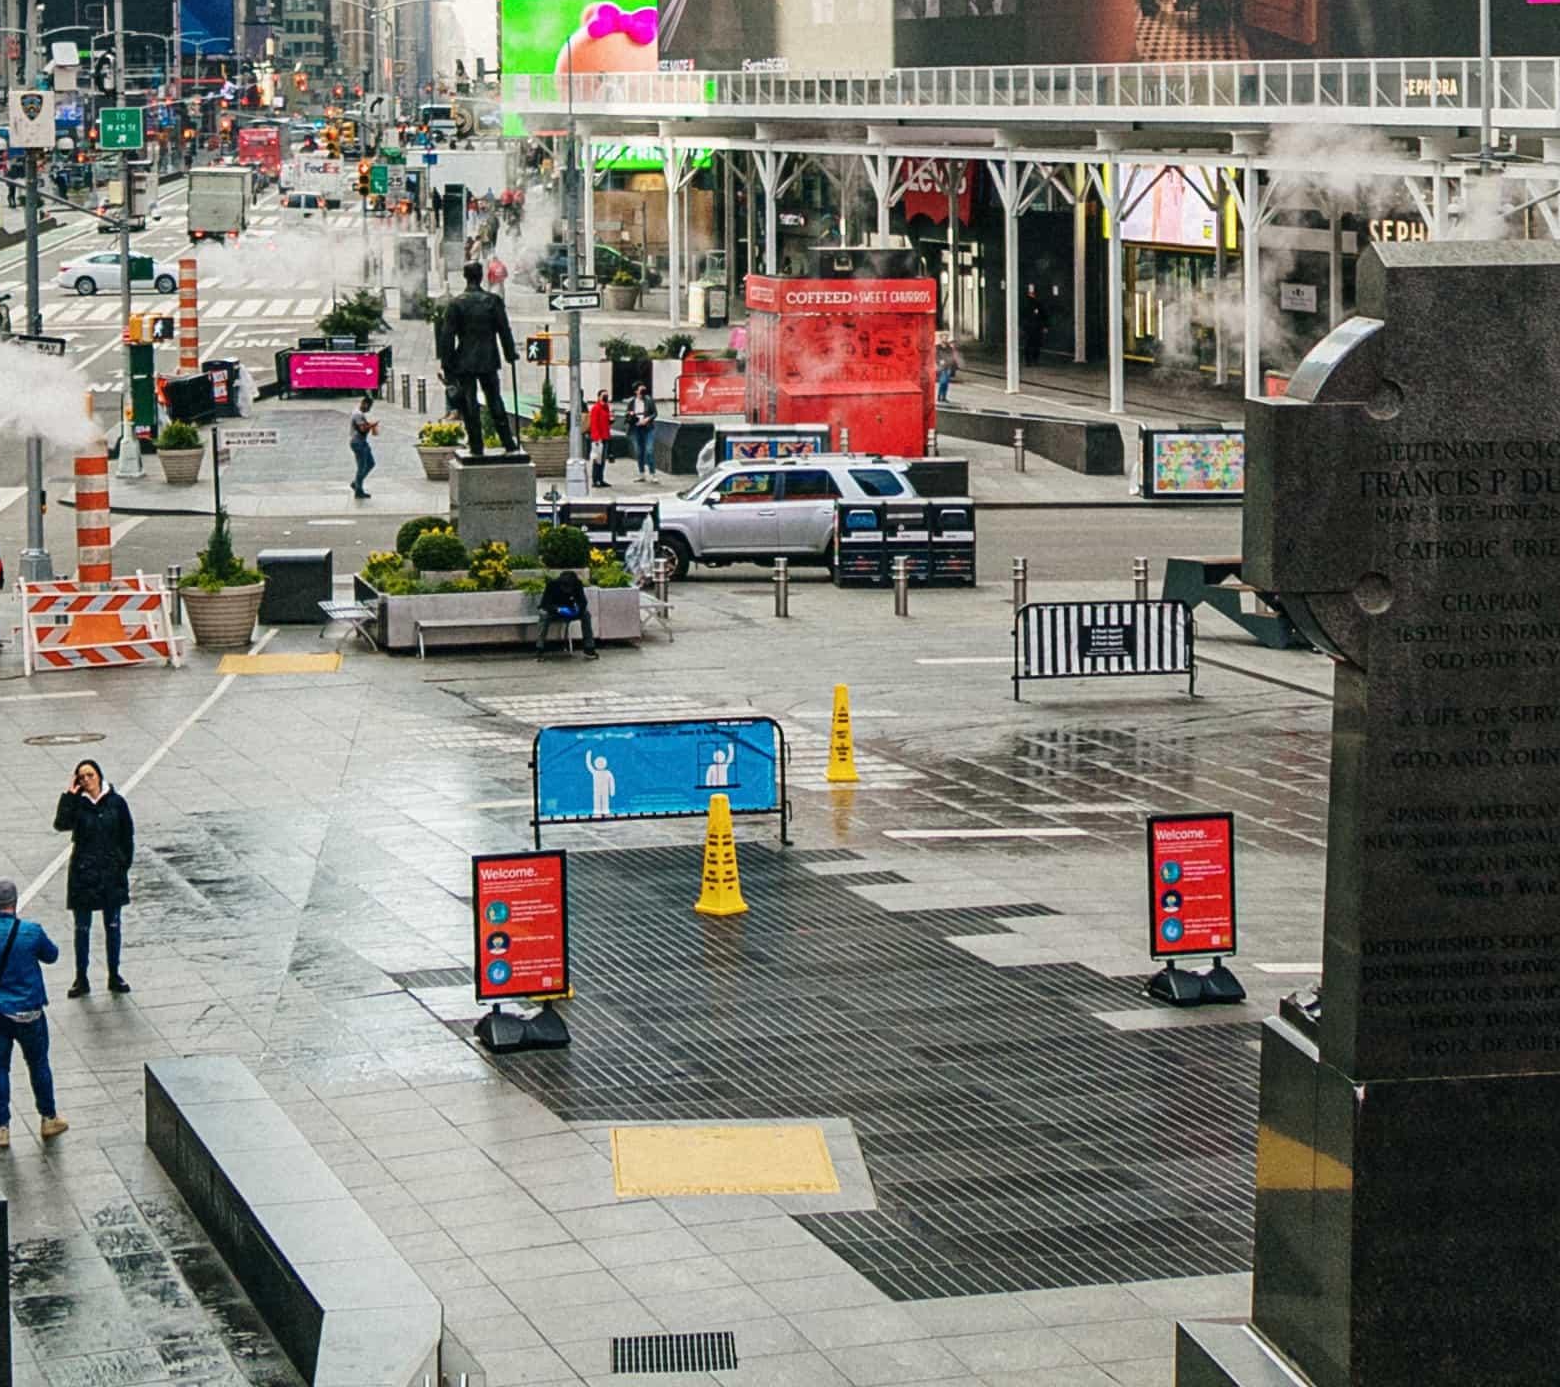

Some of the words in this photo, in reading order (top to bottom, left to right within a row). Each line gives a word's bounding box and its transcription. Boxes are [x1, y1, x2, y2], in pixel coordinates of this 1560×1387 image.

[785, 290, 853, 305] COFFEED
[1359, 469, 1482, 500] FRANCIS
[1393, 538, 1501, 562] CATHOLIC
[1155, 827, 1208, 841] Welcome.
[480, 866, 539, 881] Welcome.
